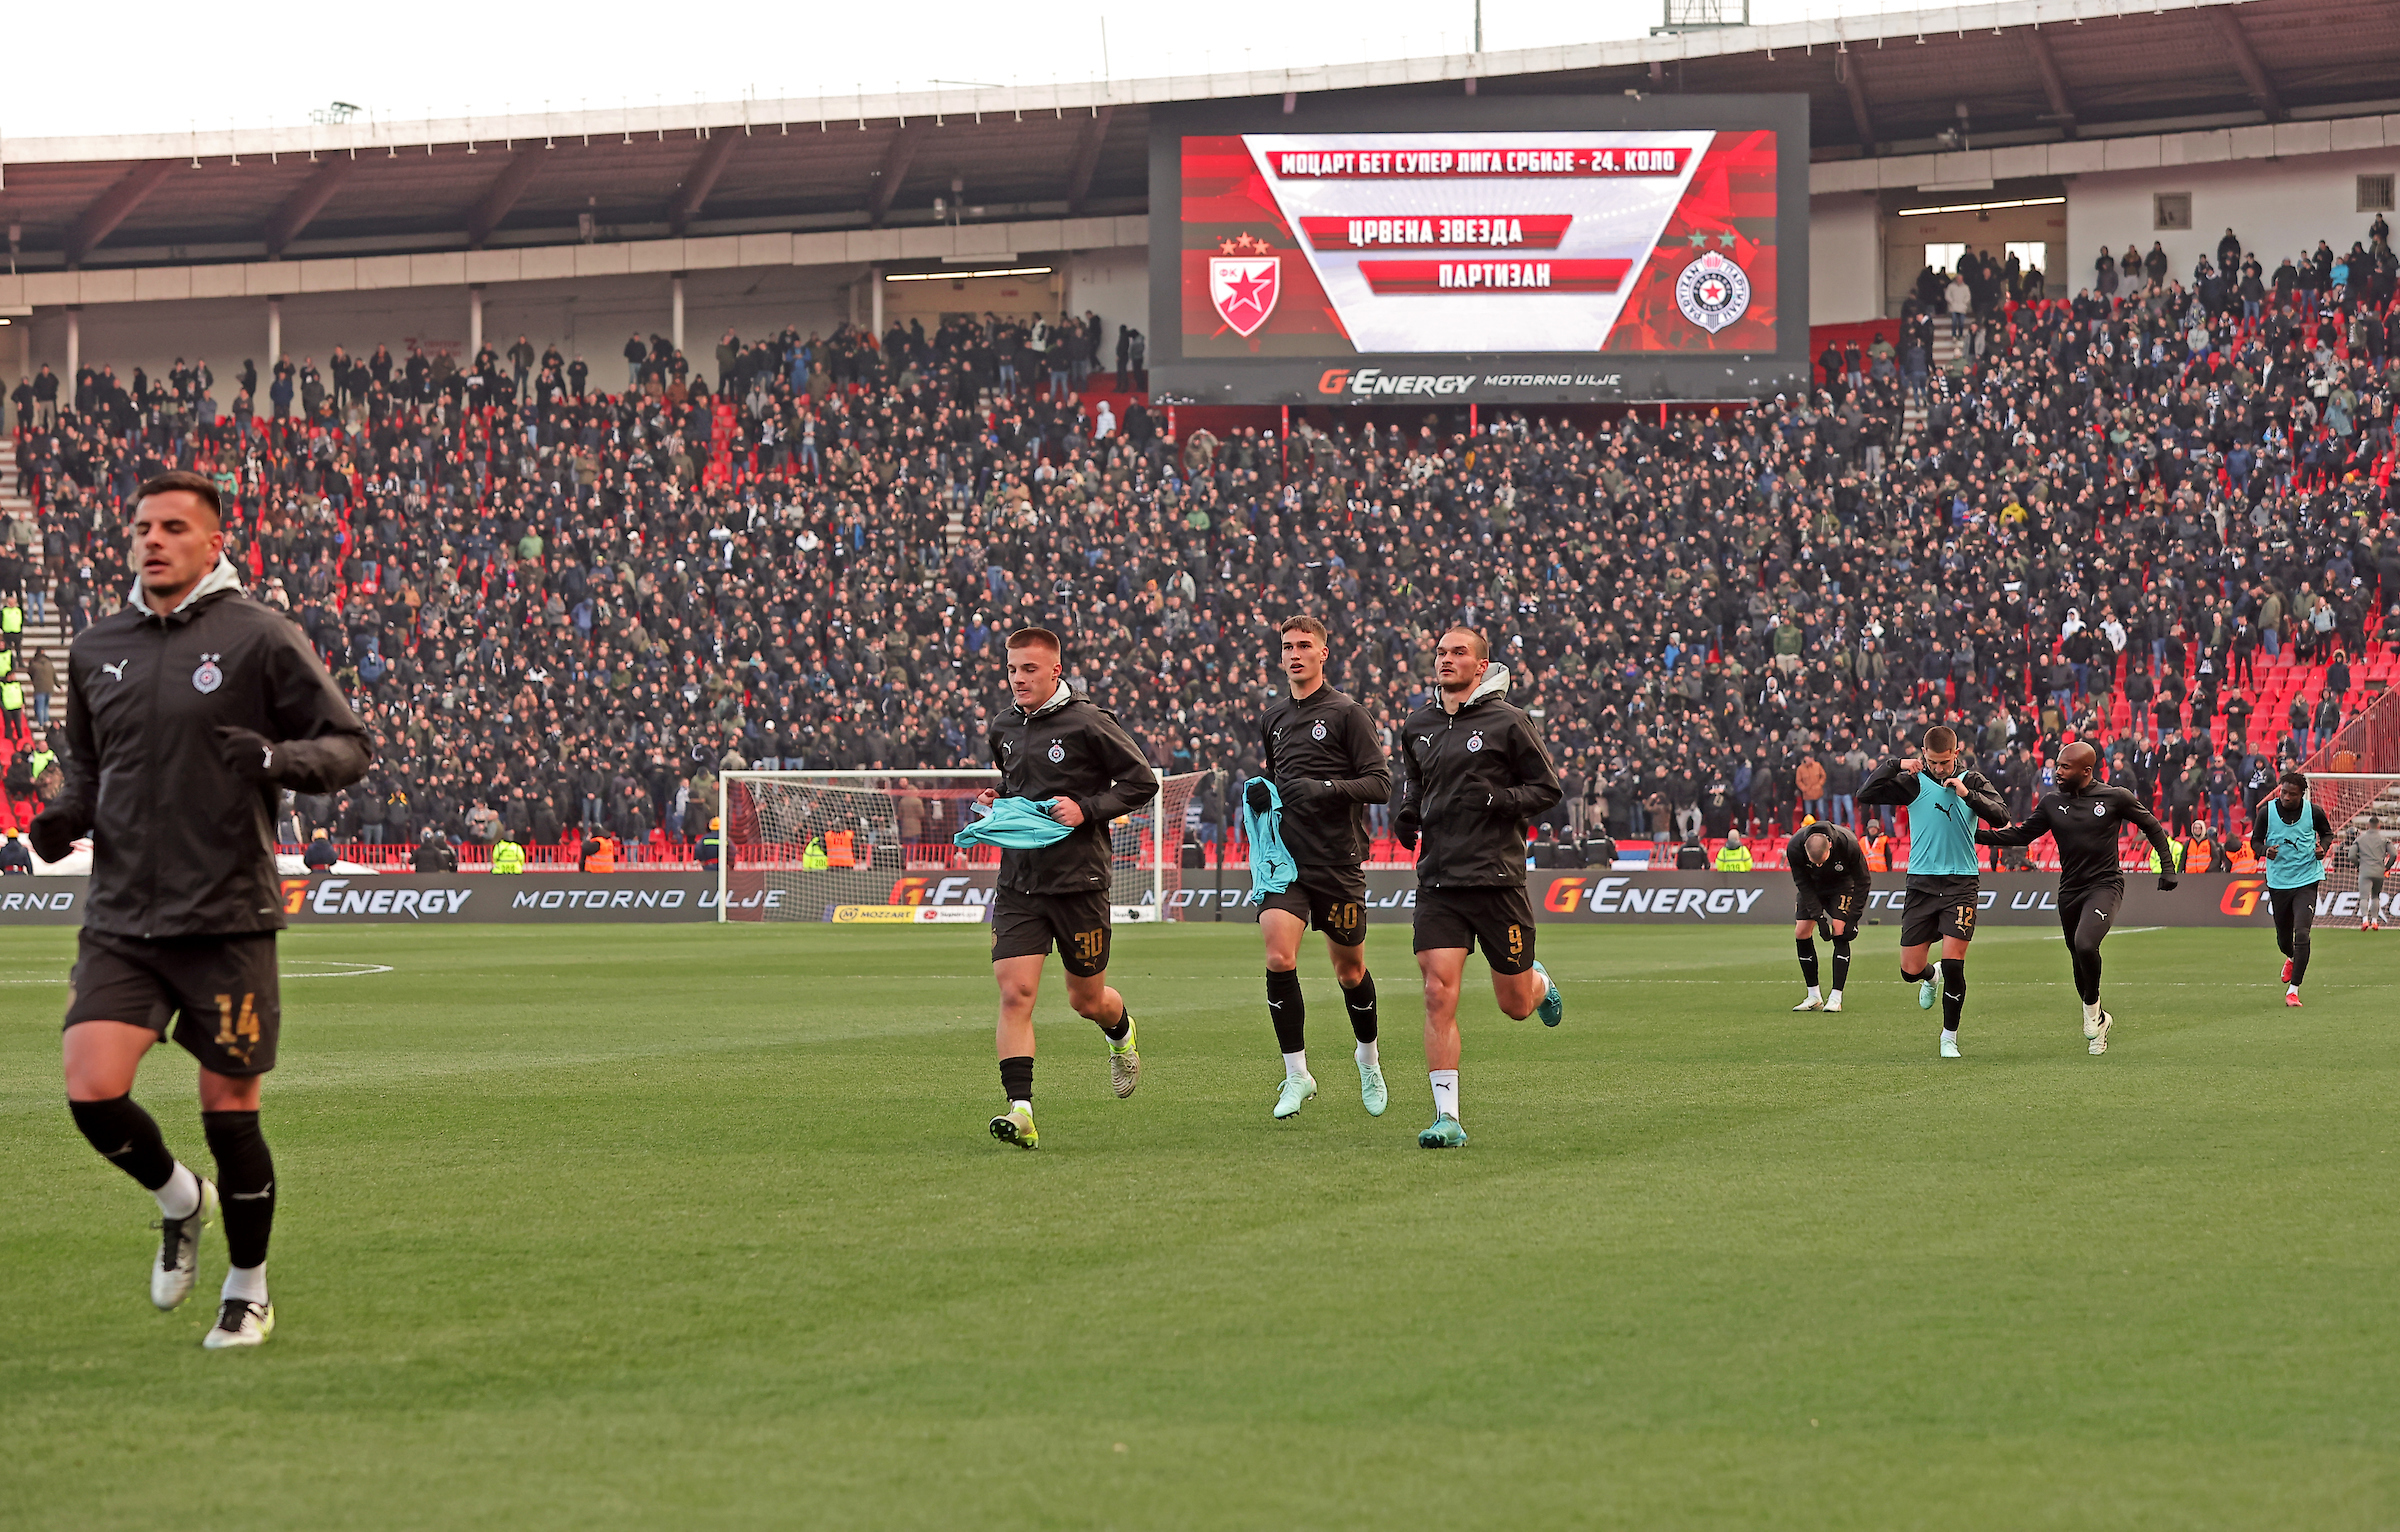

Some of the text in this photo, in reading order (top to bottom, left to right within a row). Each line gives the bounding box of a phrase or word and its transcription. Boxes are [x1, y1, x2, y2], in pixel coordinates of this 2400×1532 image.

[1281, 153, 1355, 177] МОЦАРТ
[1358, 153, 1392, 174] БЕТ
[1395, 152, 1452, 174] СУПЕР
[1456, 152, 1503, 173] ЛИГА
[1506, 151, 1575, 172] СРБИЈЕ
[1590, 151, 1621, 172] 24.
[1624, 150, 1676, 172] КОЛО
[1348, 218, 1524, 247] ЦРВЕНА ЗВЕЗДА
[1438, 263, 1551, 288] ПАРТИЗАН
[1484, 374, 1571, 386] MOTORNO
[1575, 374, 1621, 386] ULJE
[0, 892, 75, 911] RNO
[512, 890, 686, 908] MOTORNO
[1328, 903, 1358, 930] 40
[1955, 905, 1975, 927] 12
[1074, 928, 1103, 960] 30
[1508, 924, 1523, 955] 9
[214, 992, 260, 1044] 14
